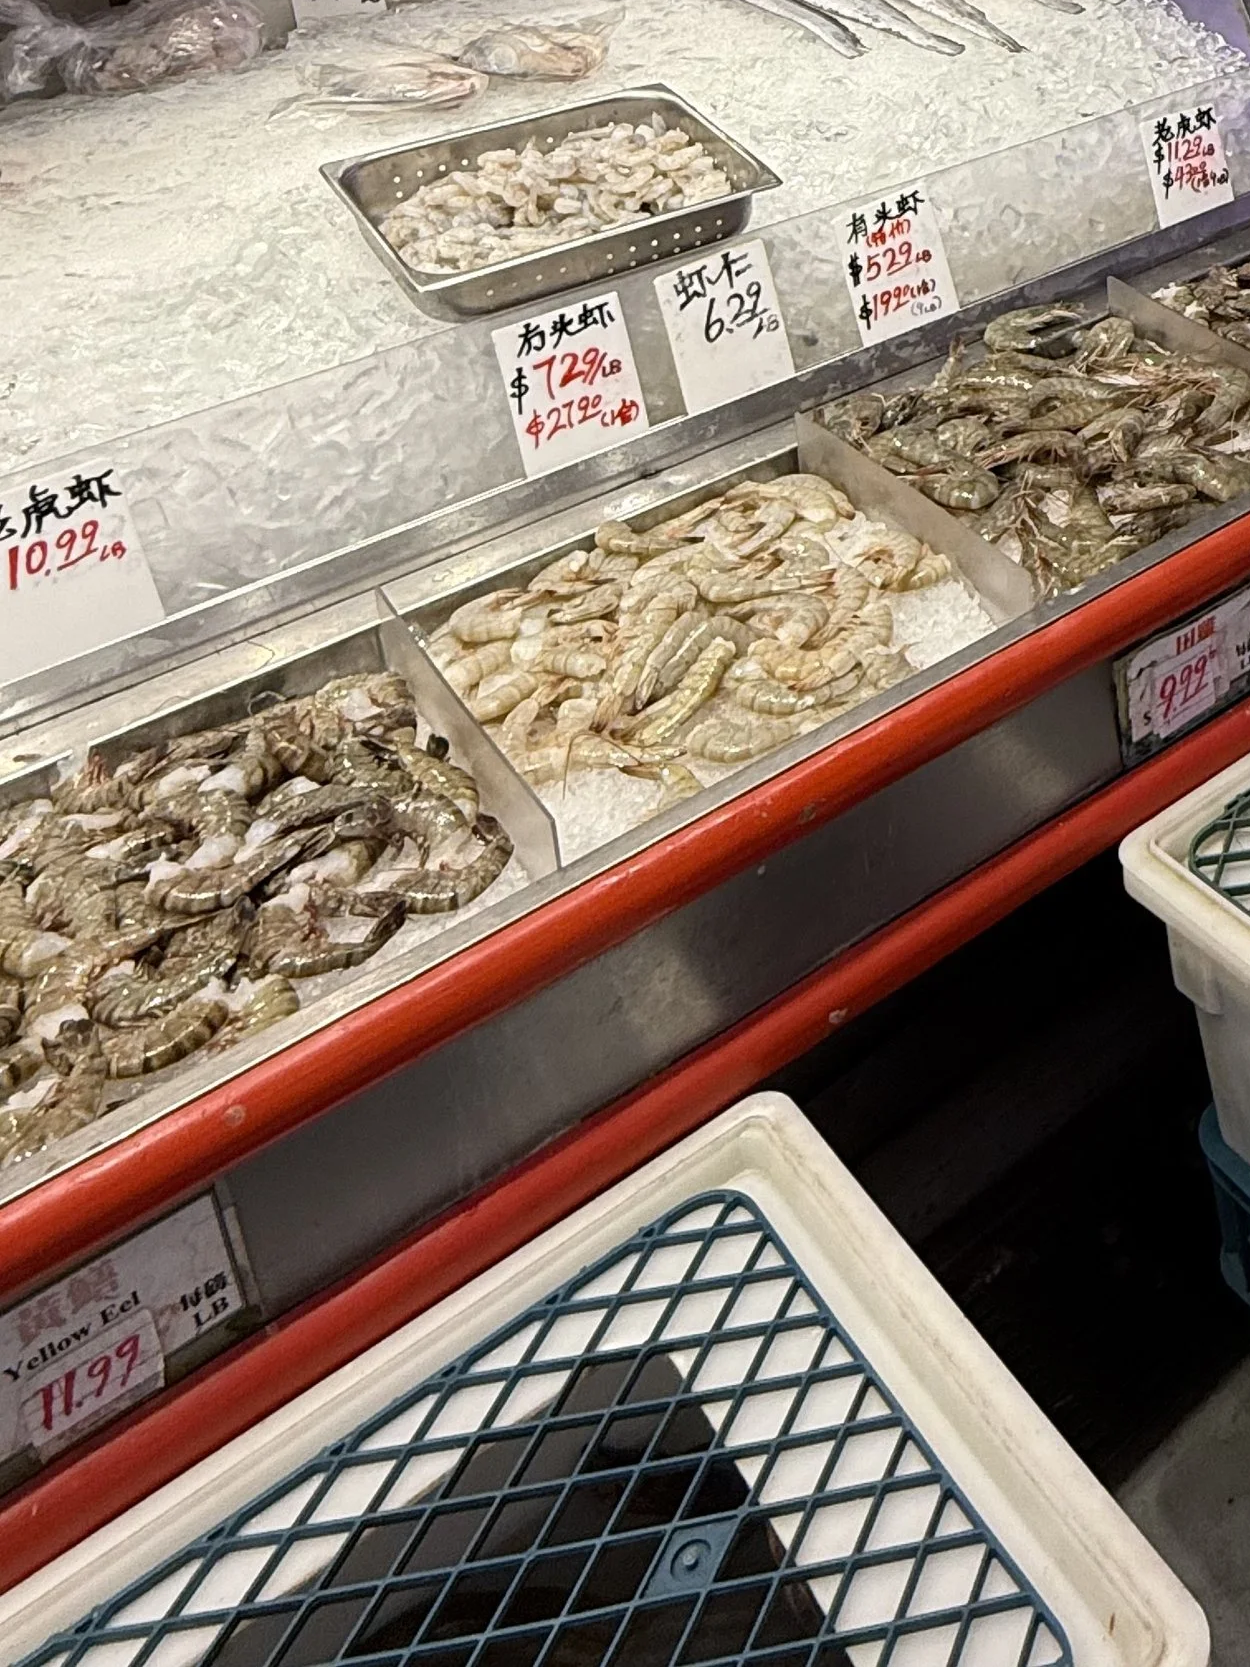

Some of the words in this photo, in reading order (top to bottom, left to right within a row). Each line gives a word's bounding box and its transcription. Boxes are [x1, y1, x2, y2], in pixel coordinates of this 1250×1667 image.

[3, 1322, 93, 1383] Yellow
[100, 1290, 142, 1326] Eel
[193, 1296, 230, 1328] LB
